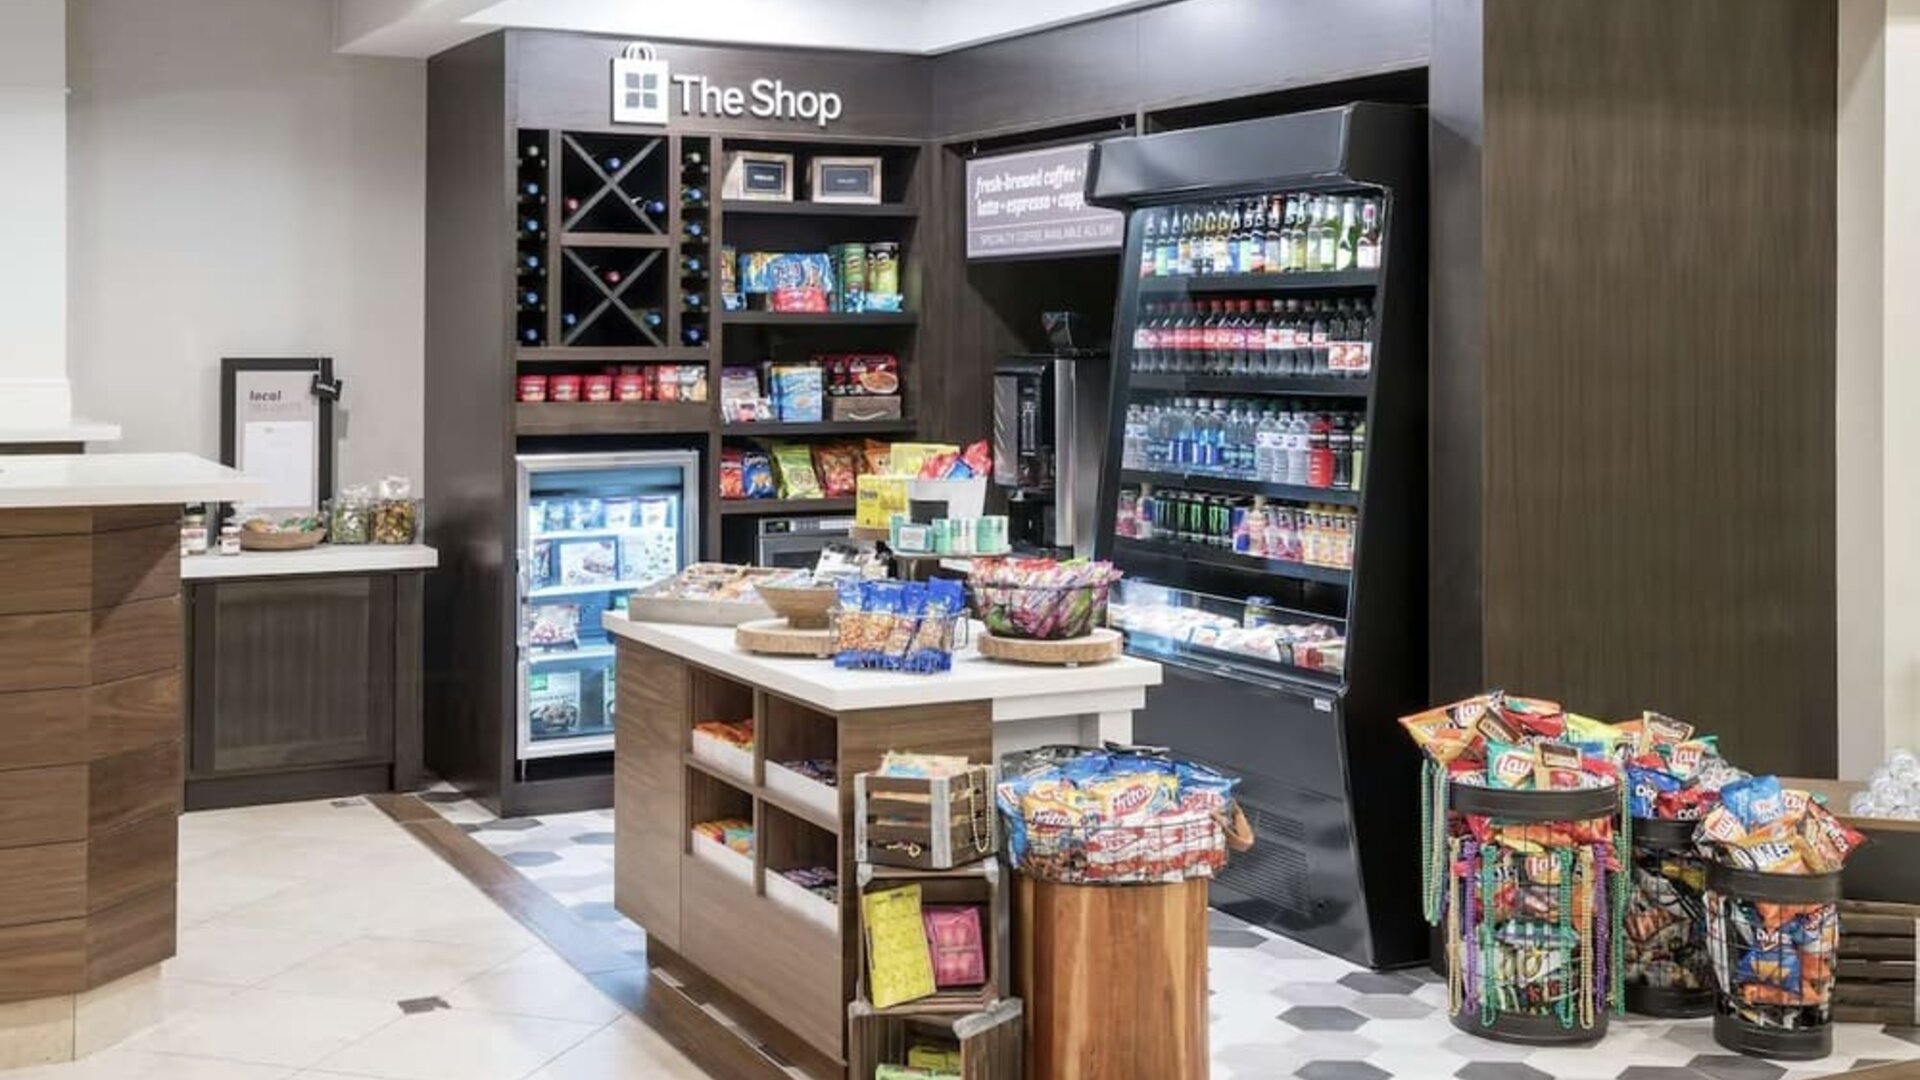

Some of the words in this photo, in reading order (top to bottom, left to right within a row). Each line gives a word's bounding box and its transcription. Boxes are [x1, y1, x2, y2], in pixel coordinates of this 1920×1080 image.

[673, 74, 745, 115] The
[750, 78, 842, 127] Shop
[975, 168, 1043, 199] fresh-brewed
[1044, 165, 1076, 189] coffee
[1006, 195, 1050, 217] espresso
[249, 390, 281, 401] local
